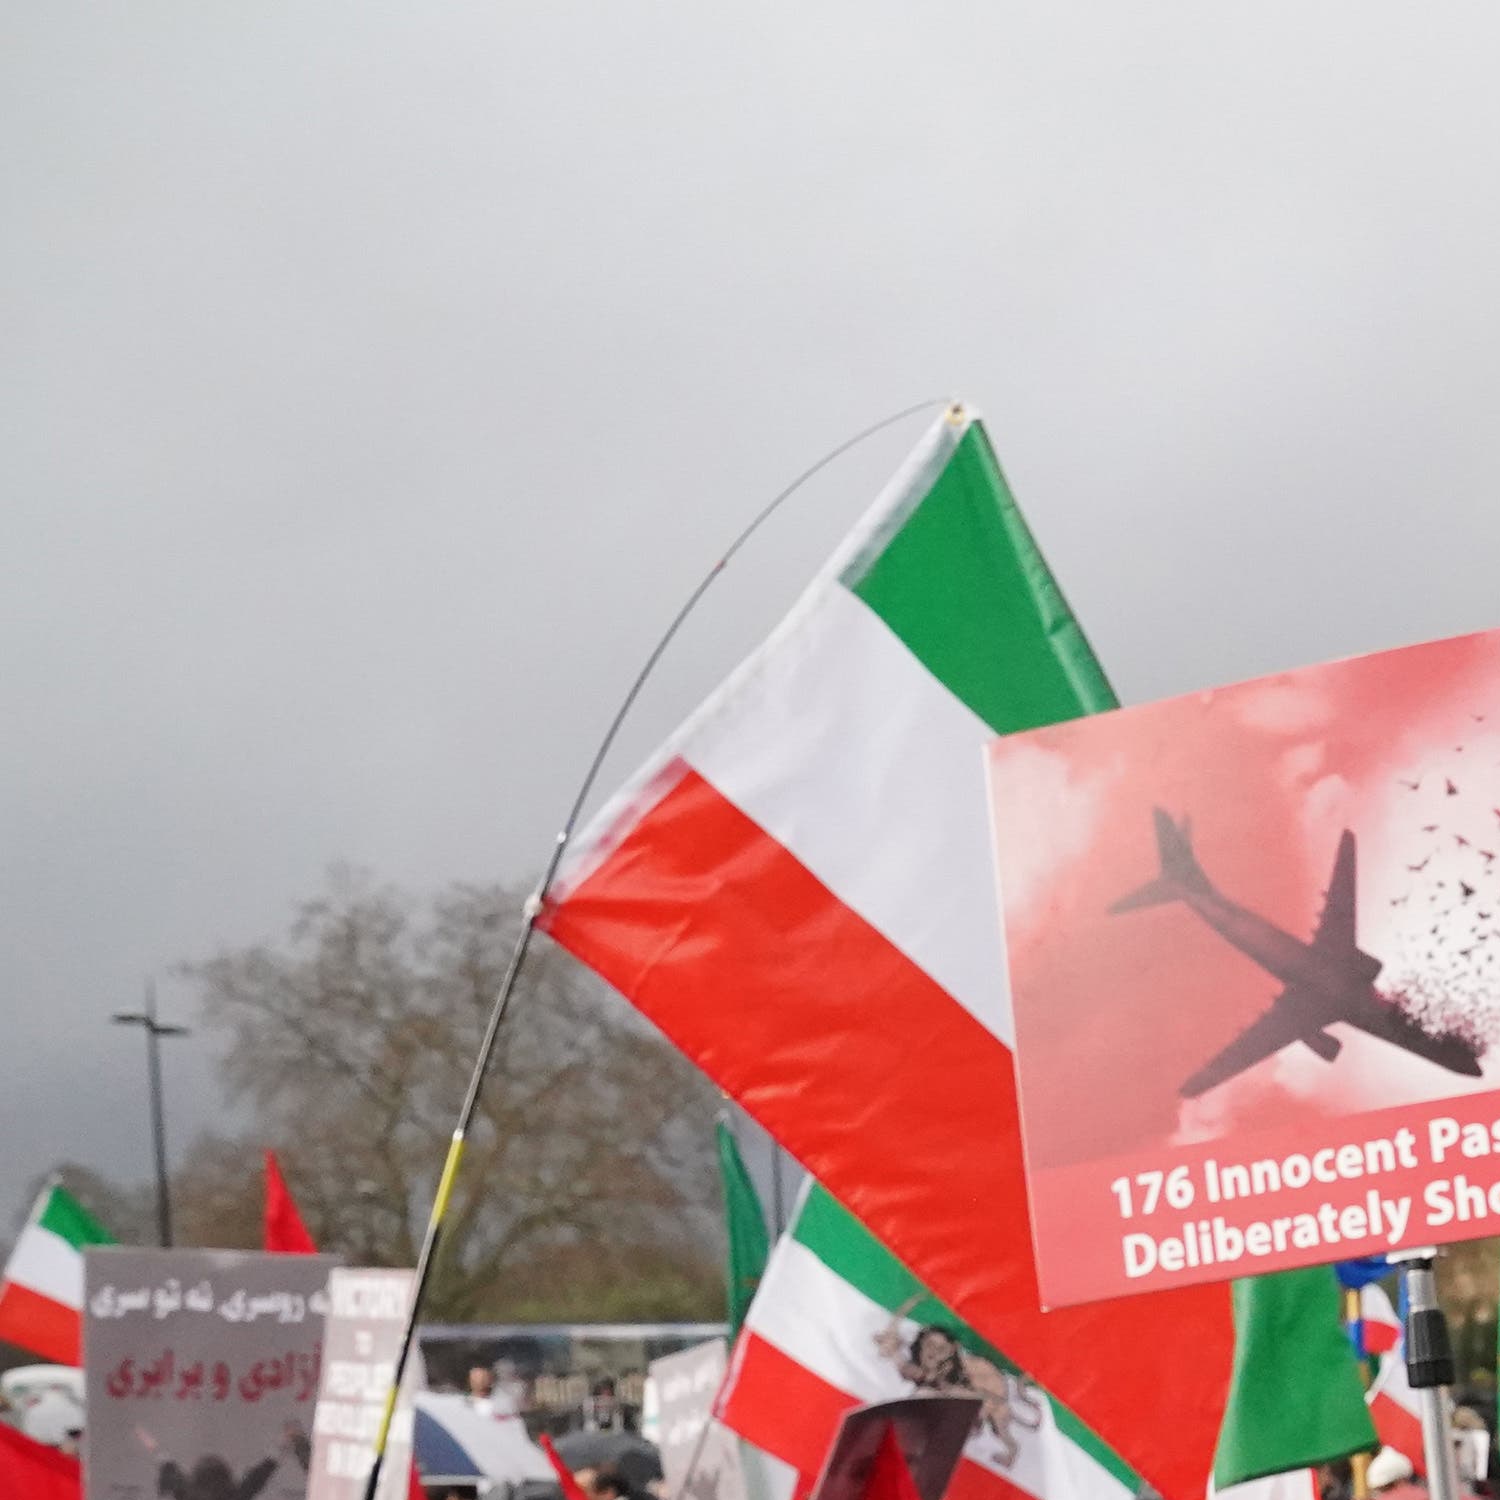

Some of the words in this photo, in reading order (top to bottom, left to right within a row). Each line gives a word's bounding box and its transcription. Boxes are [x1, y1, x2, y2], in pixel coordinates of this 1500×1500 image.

[1110, 1164, 1197, 1220] 176
[1203, 1127, 1419, 1204] Innocent
[1122, 1188, 1412, 1279] Deliberately
